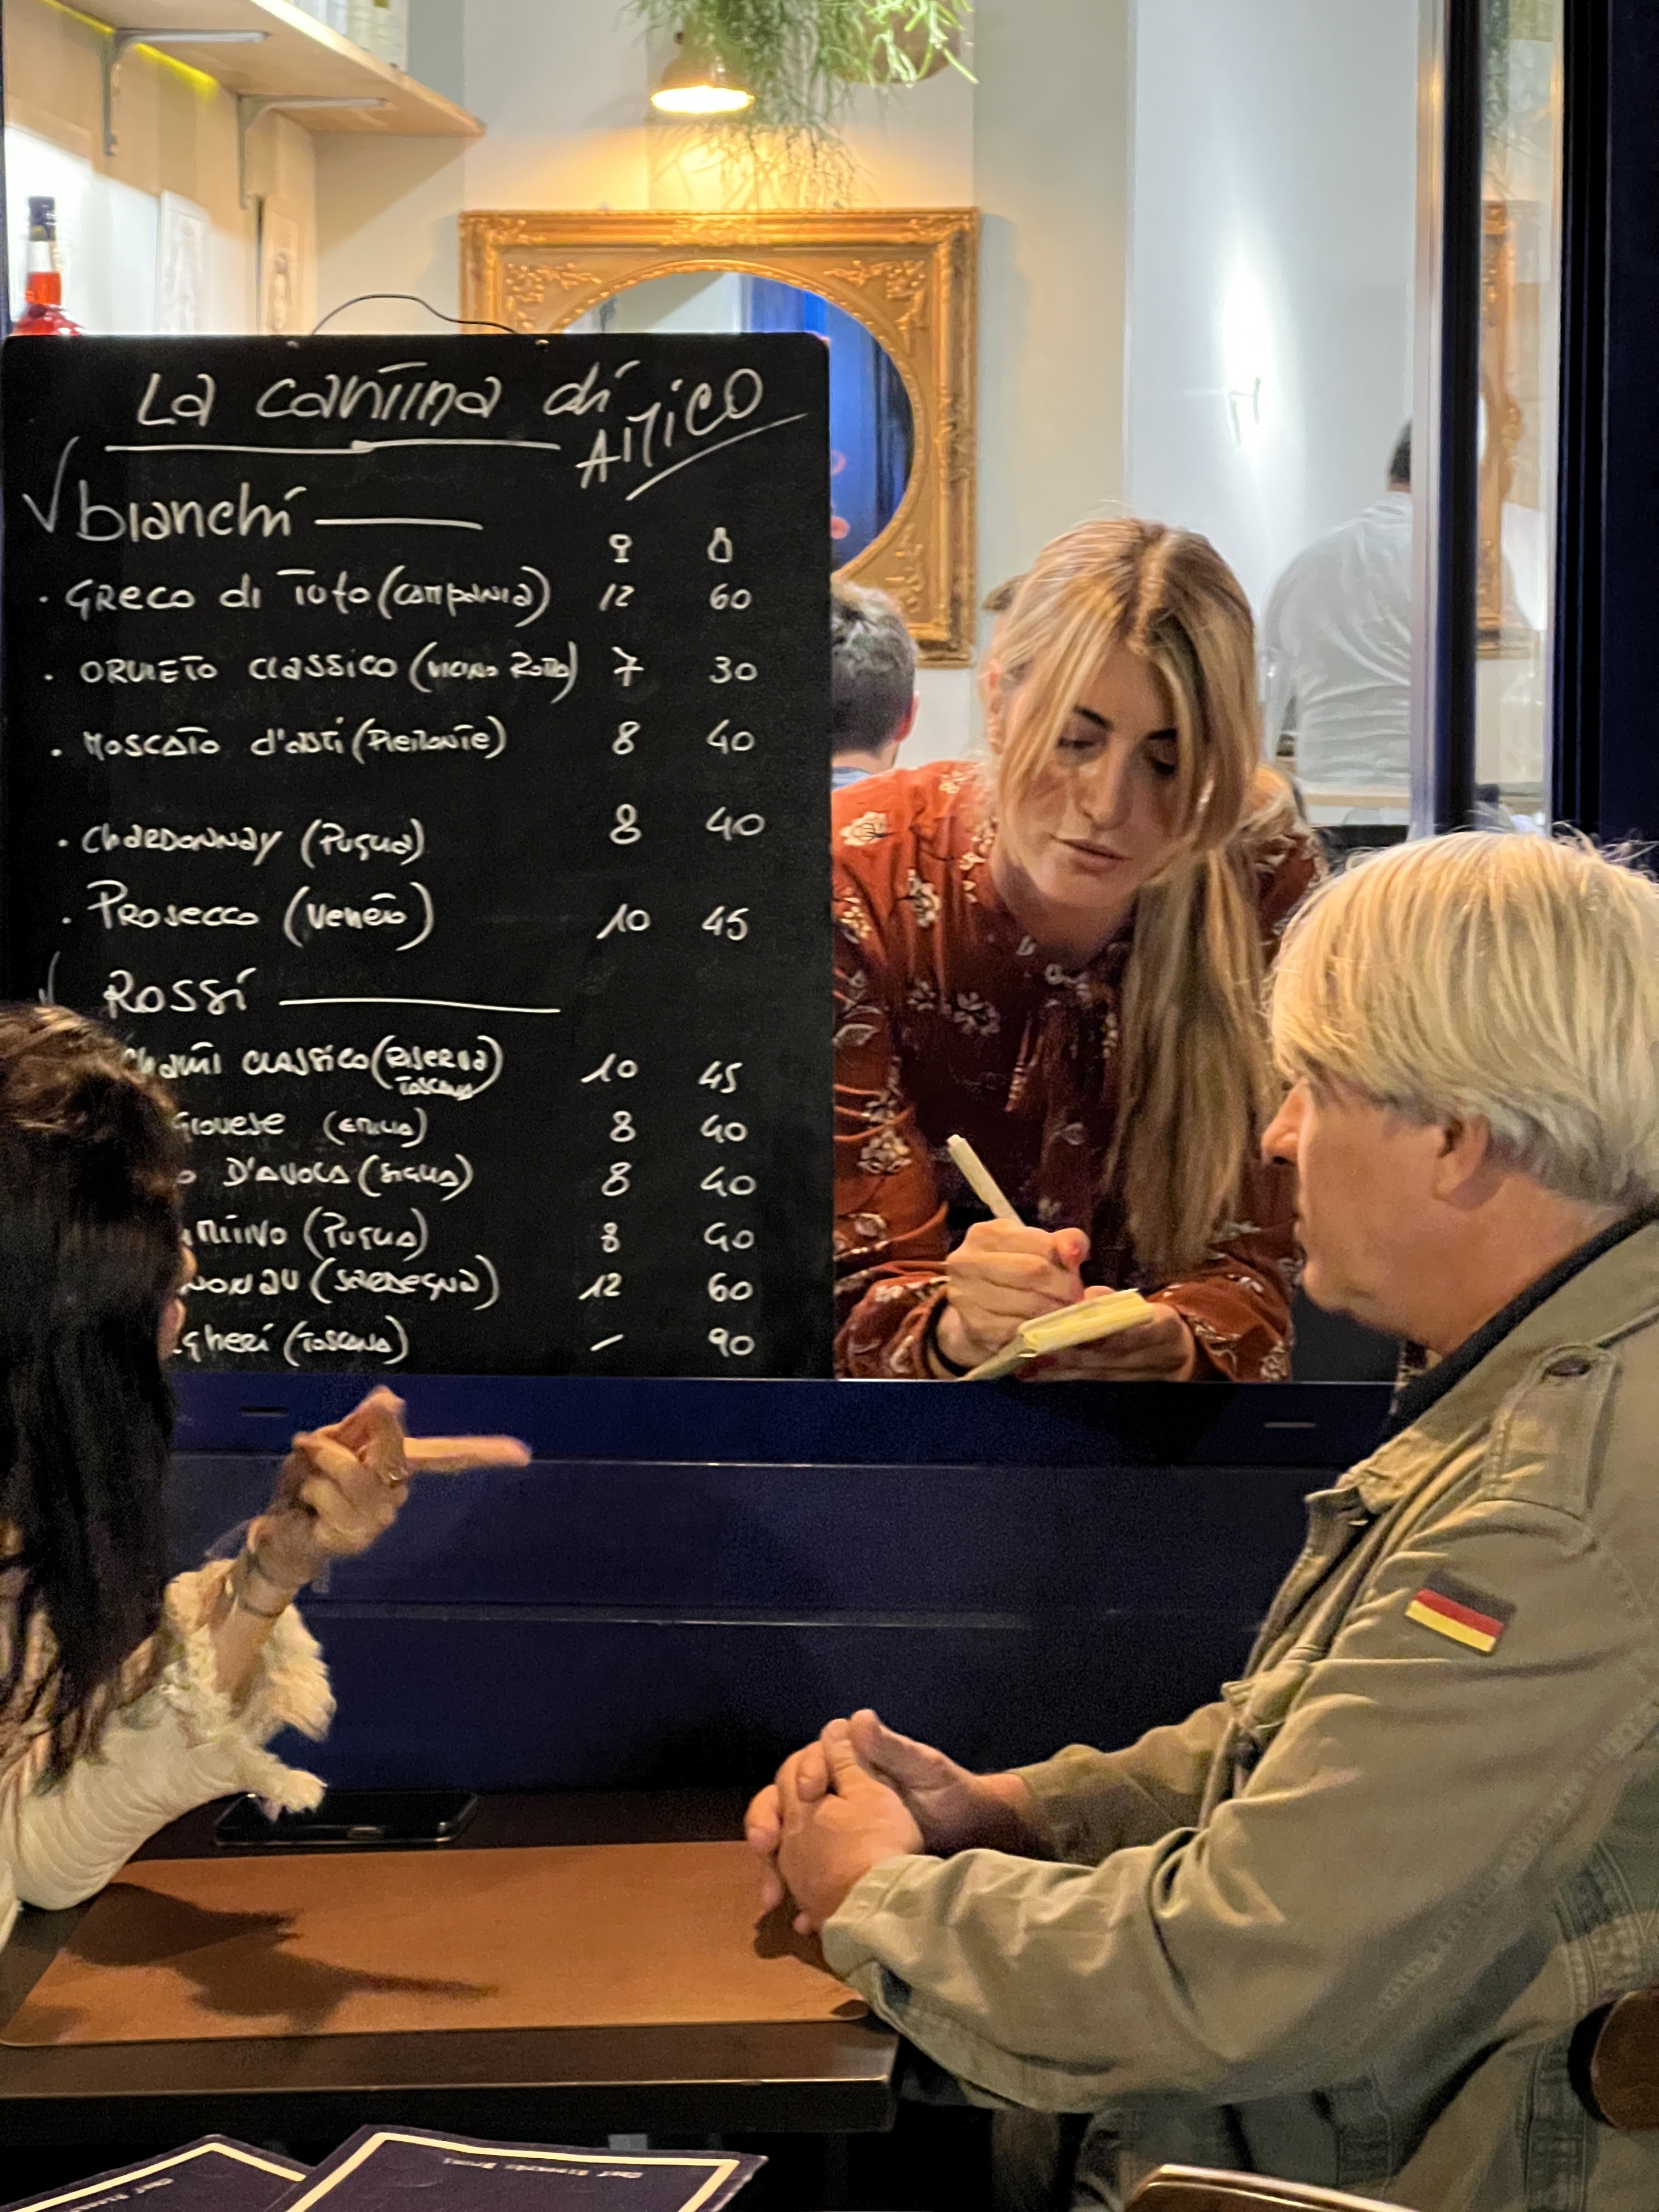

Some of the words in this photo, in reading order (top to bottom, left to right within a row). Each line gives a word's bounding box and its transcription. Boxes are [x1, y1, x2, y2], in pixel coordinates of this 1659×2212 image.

[137, 373, 215, 427] La
[543, 360, 640, 416] di
[77, 479, 307, 542] bianchi
[219, 573, 261, 608] di
[599, 583, 635, 611] 12
[709, 583, 752, 610] 60
[611, 646, 645, 687] 7
[709, 656, 758, 684] 30
[612, 721, 641, 755] 8
[707, 719, 755, 754] 40
[610, 803, 641, 845] 8
[706, 806, 765, 841] 40
[596, 904, 650, 940] 10
[702, 905, 749, 941] 45
[580, 1053, 638, 1084] 10
[698, 1060, 743, 1094] 45
[610, 1110, 636, 1143] 8
[700, 1114, 748, 1144] 40
[601, 1161, 632, 1197] 8
[700, 1166, 756, 1197] 40
[600, 1222, 620, 1253] 8
[703, 1222, 754, 1252] 40
[578, 1272, 622, 1300] 12
[707, 1272, 753, 1302] 60
[708, 1327, 755, 1357] 90
